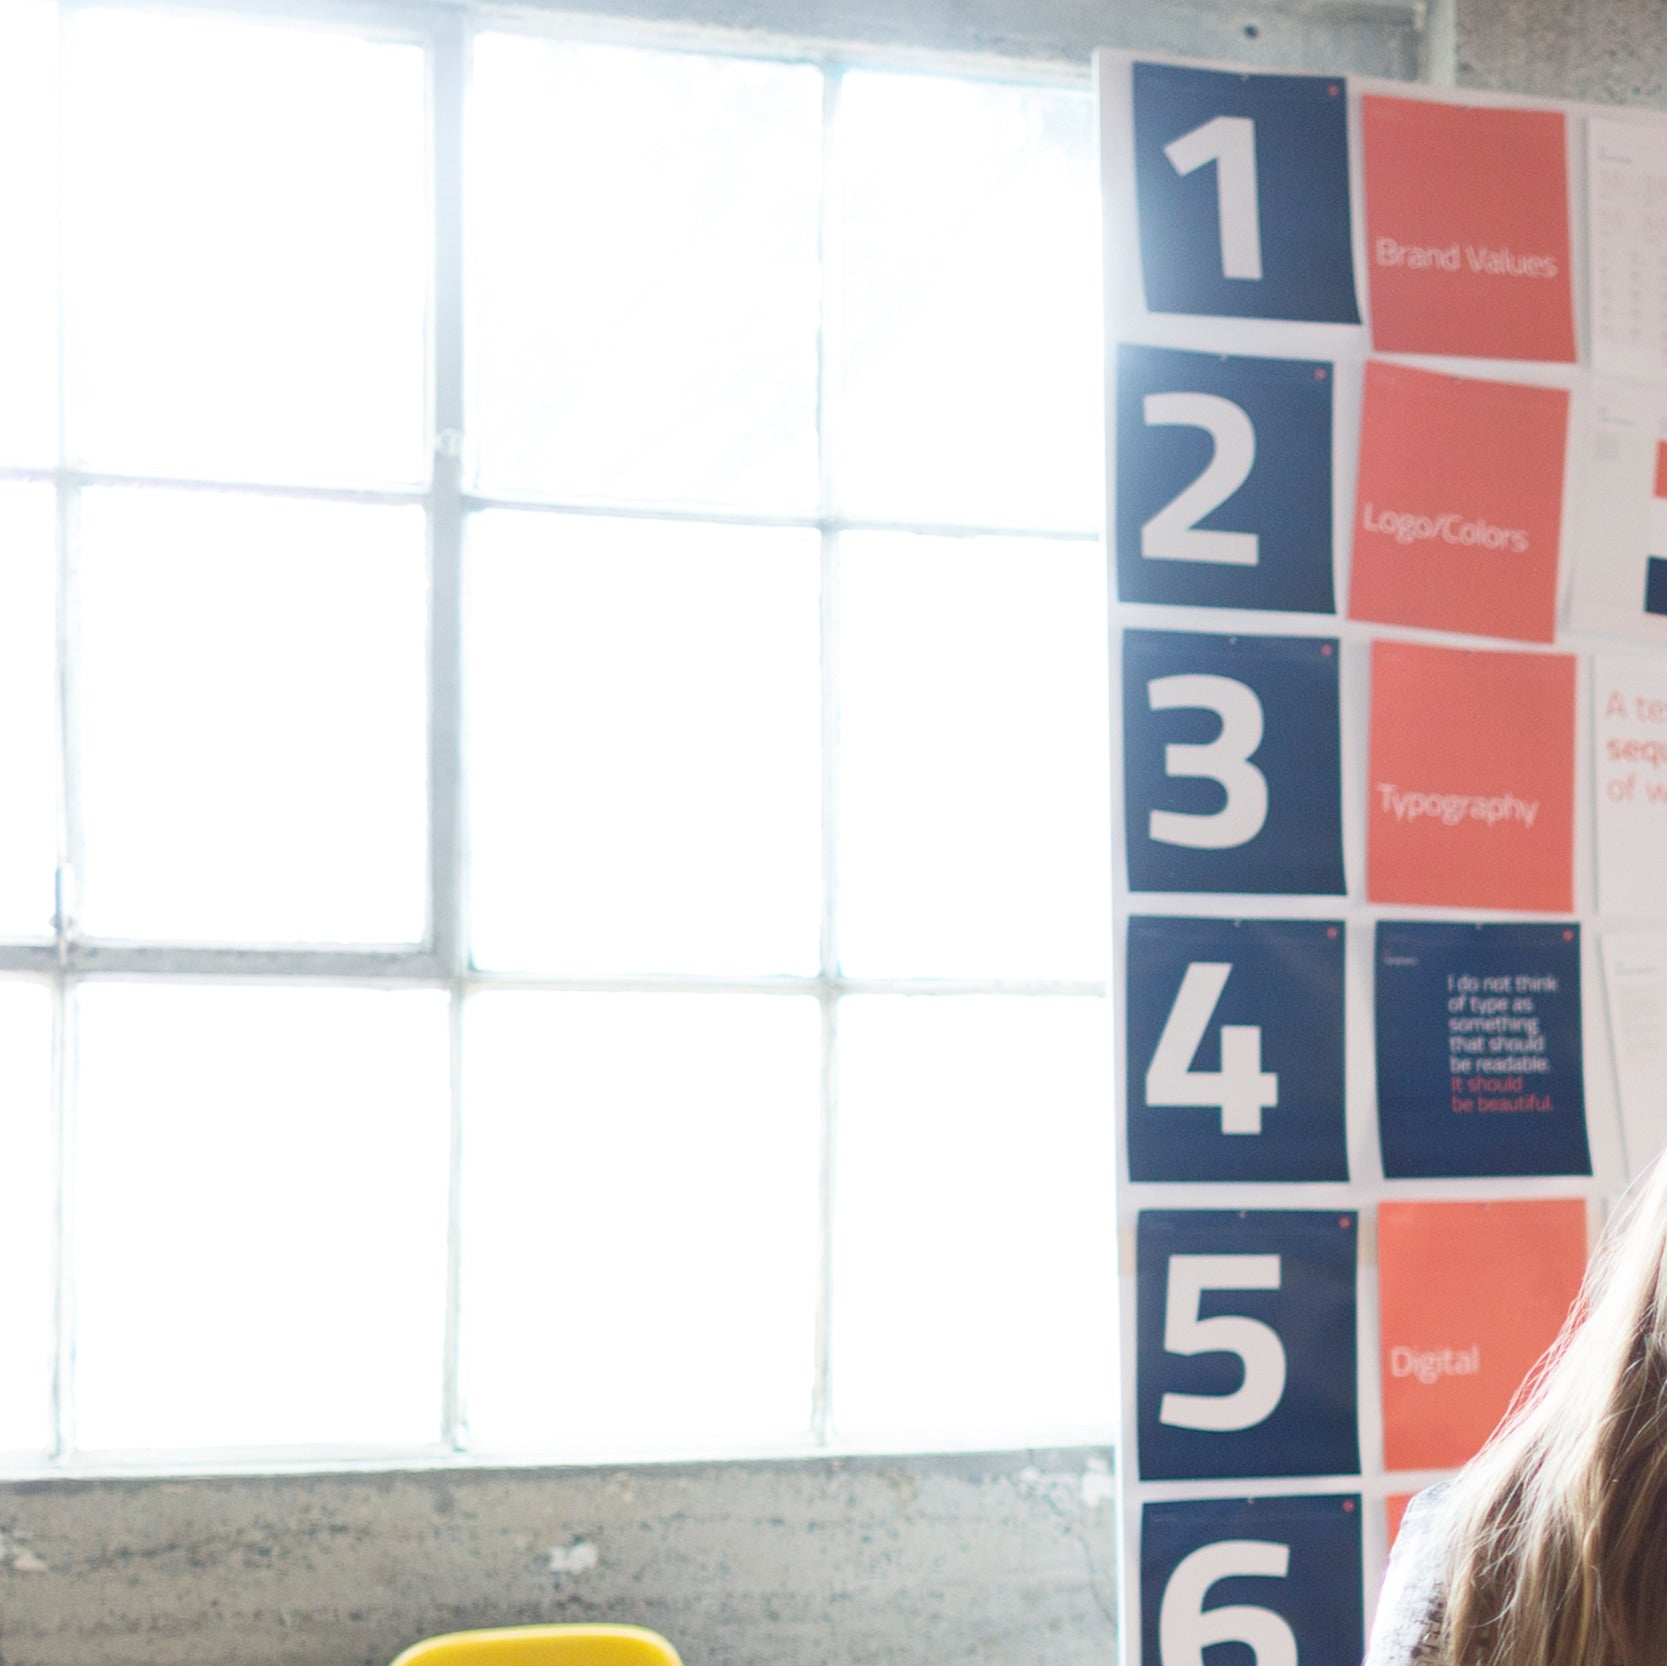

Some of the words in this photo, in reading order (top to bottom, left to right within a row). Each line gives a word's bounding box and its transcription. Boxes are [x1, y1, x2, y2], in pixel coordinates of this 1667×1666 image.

[1163, 116, 1263, 280] 1
[1375, 236, 1462, 273] Brand
[1464, 242, 1559, 278] Values
[1142, 392, 1259, 566] 2
[1363, 502, 1530, 553] Logo/Colors
[1605, 691, 1629, 719] A
[1147, 674, 1268, 849] 3
[1606, 771, 1637, 802] of
[1376, 782, 1540, 829] Typography
[1447, 975, 1454, 991] I
[1457, 975, 1479, 992] do
[1483, 976, 1511, 992] not
[1515, 975, 1558, 992] think
[1448, 995, 1466, 1012] of
[1470, 997, 1507, 1014] type
[1512, 998, 1533, 1012] as
[1449, 1017, 1540, 1035] something
[1450, 1037, 1484, 1053] that
[1488, 1035, 1545, 1053] should
[1146, 963, 1278, 1134] 4
[1450, 1056, 1472, 1073] be
[1476, 1056, 1551, 1073] readable.
[1451, 1076, 1463, 1092] It
[1467, 1076, 1523, 1092] should
[1452, 1095, 1473, 1112] be
[1478, 1094, 1553, 1113] beautiful.
[1160, 1255, 1286, 1431] 5
[1390, 1344, 1480, 1385] Digital
